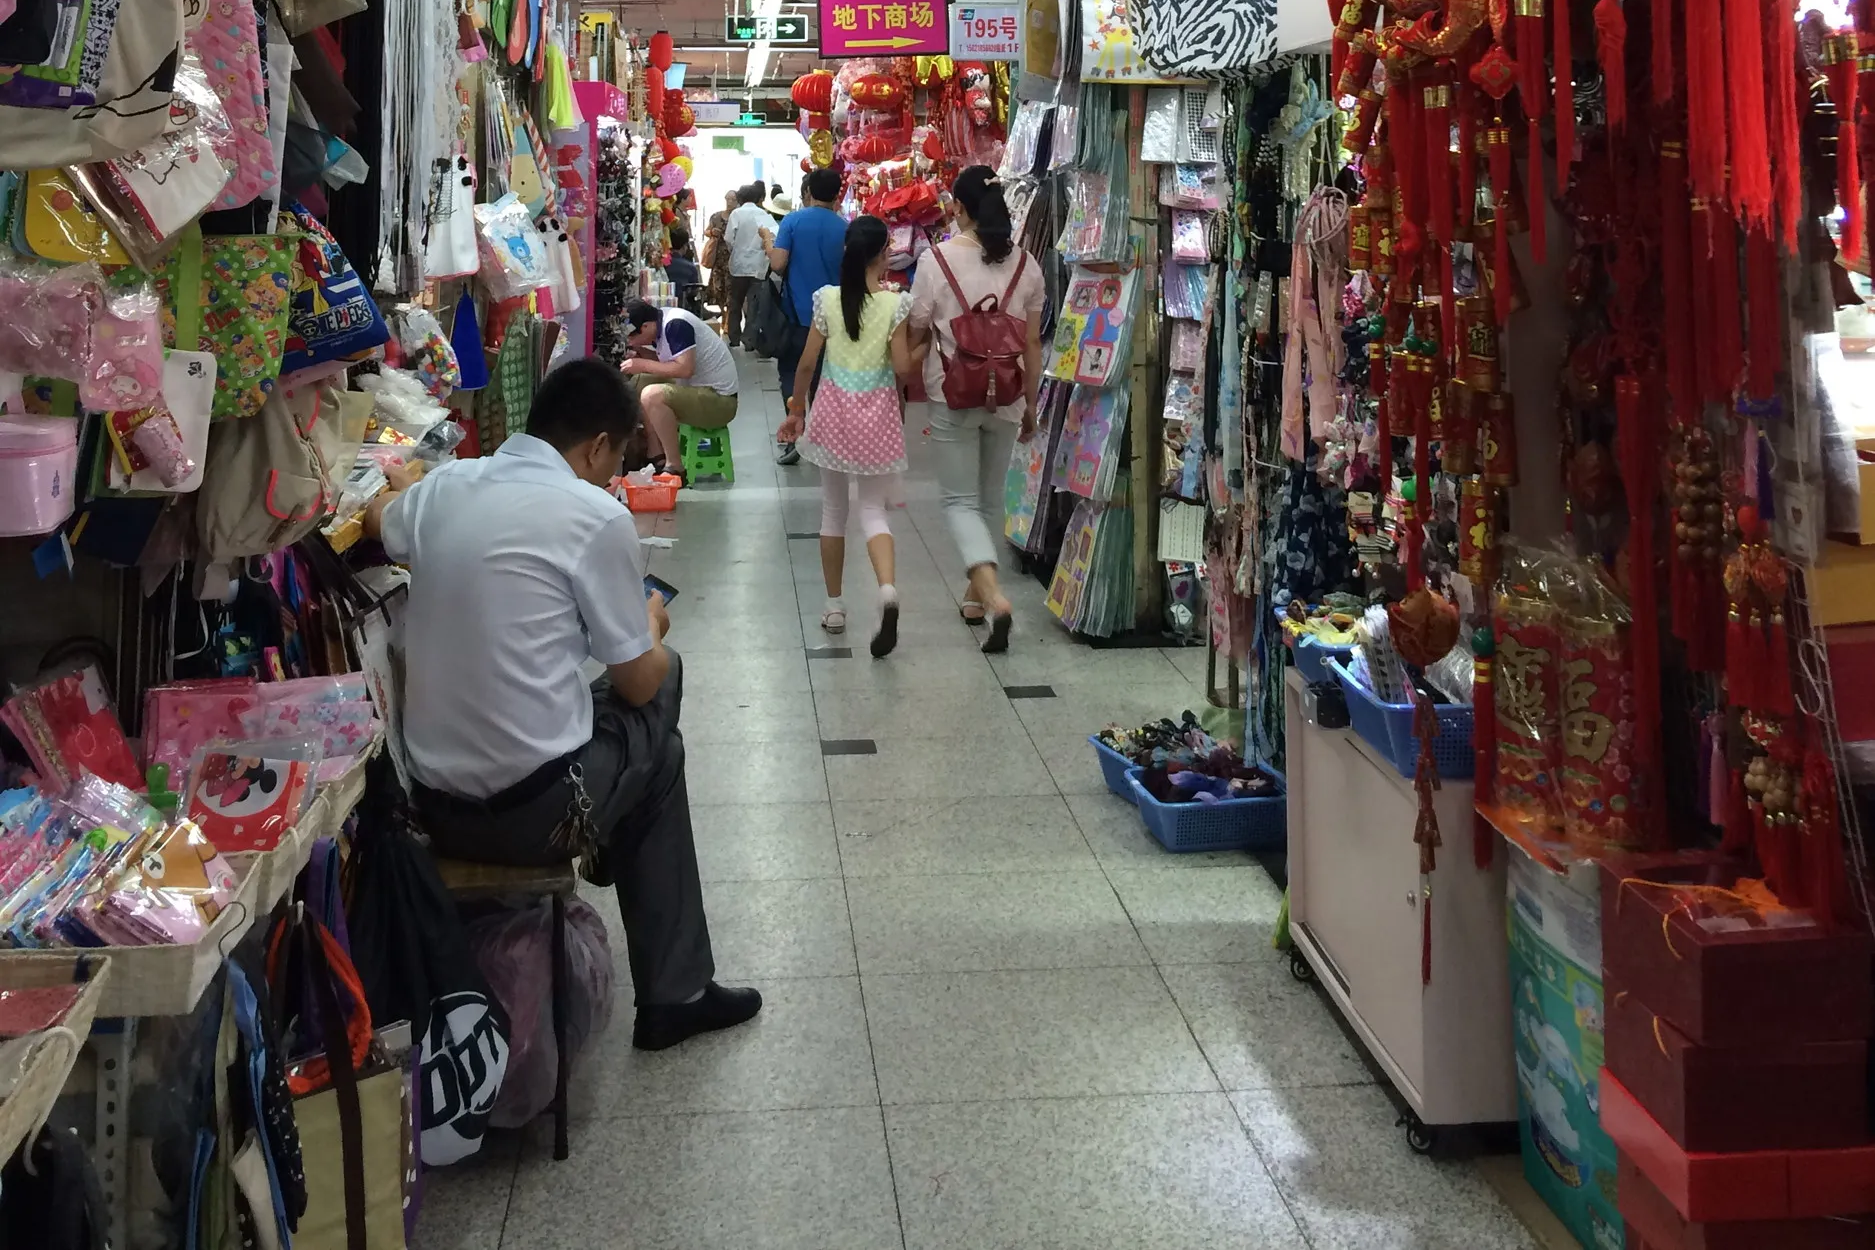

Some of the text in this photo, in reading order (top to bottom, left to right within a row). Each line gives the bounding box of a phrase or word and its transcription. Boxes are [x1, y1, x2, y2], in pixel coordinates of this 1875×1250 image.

[832, 0, 934, 31] 地下商场
[964, 16, 1018, 40] 195号
